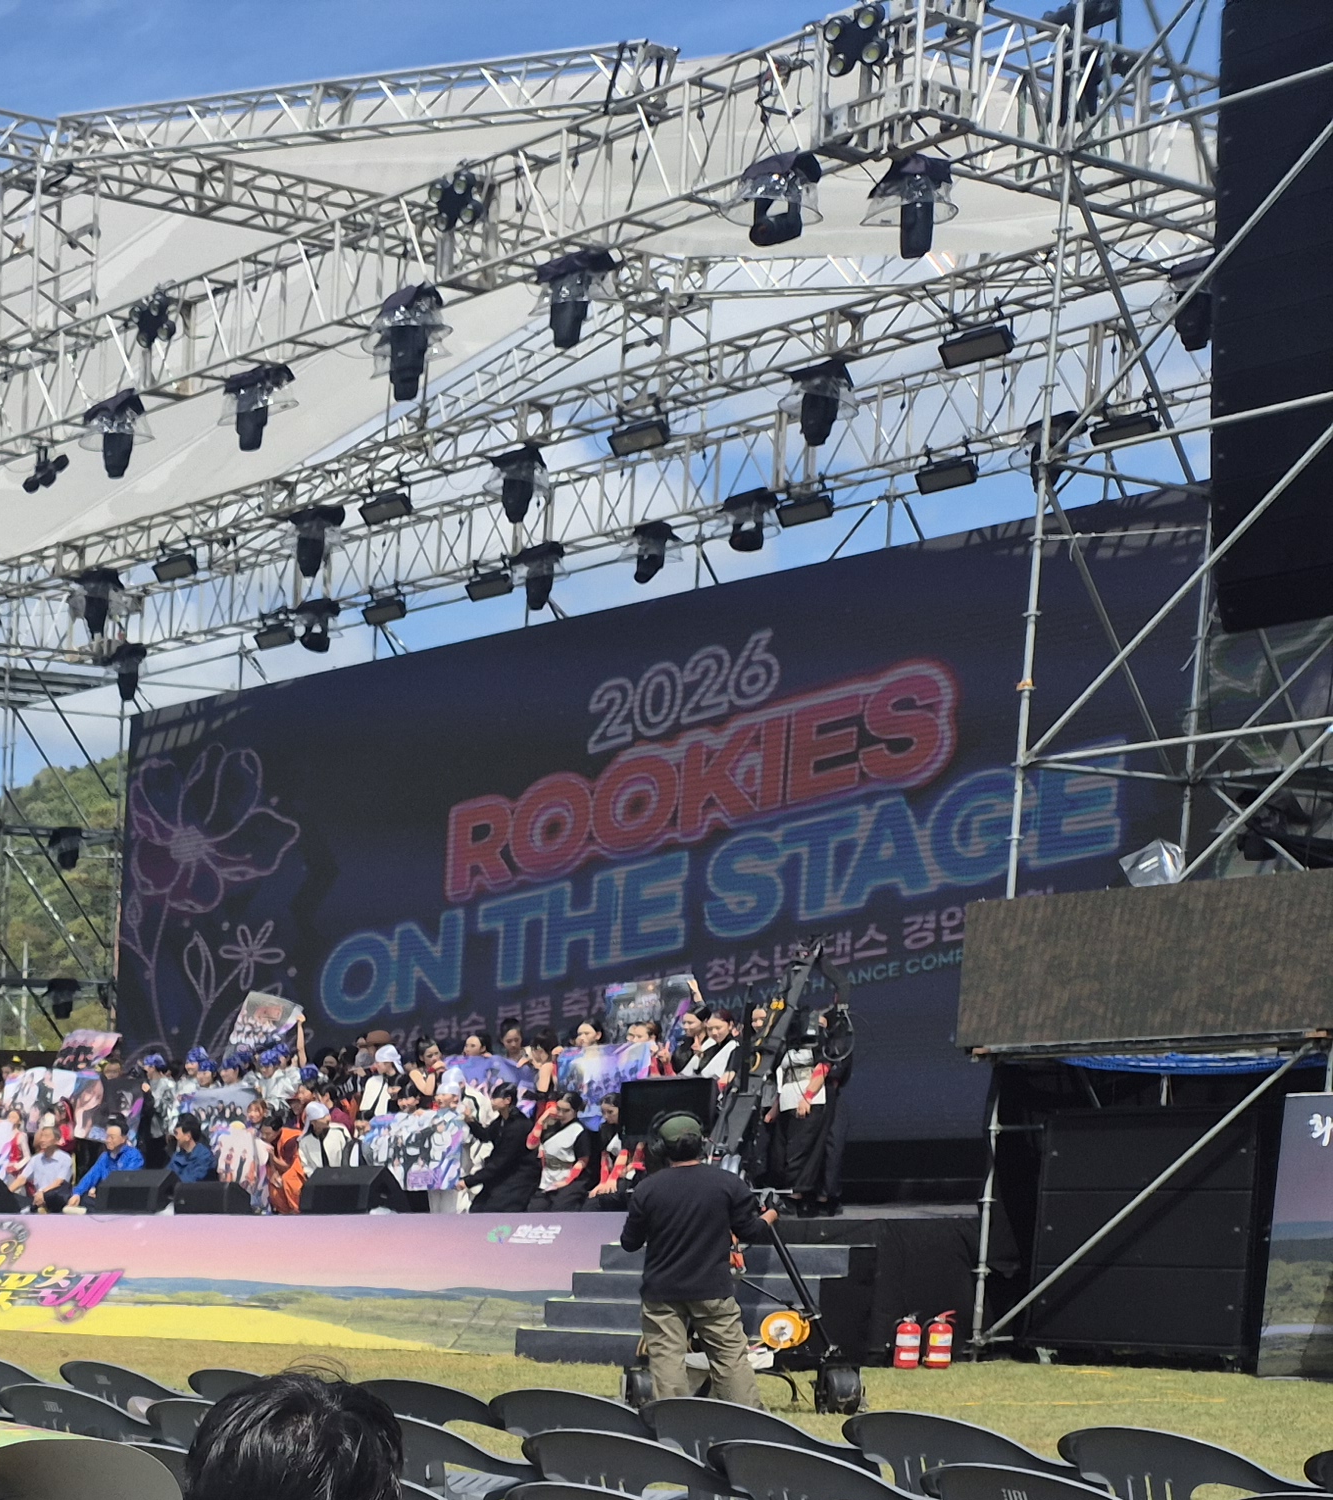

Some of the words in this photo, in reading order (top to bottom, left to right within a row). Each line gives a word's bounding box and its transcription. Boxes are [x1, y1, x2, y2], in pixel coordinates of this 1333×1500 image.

[445, 657, 961, 902] ROOKIES
[587, 627, 781, 755] 2026
[319, 908, 466, 1026] ON
[478, 850, 693, 992] THE
[703, 738, 1131, 940] STAGE
